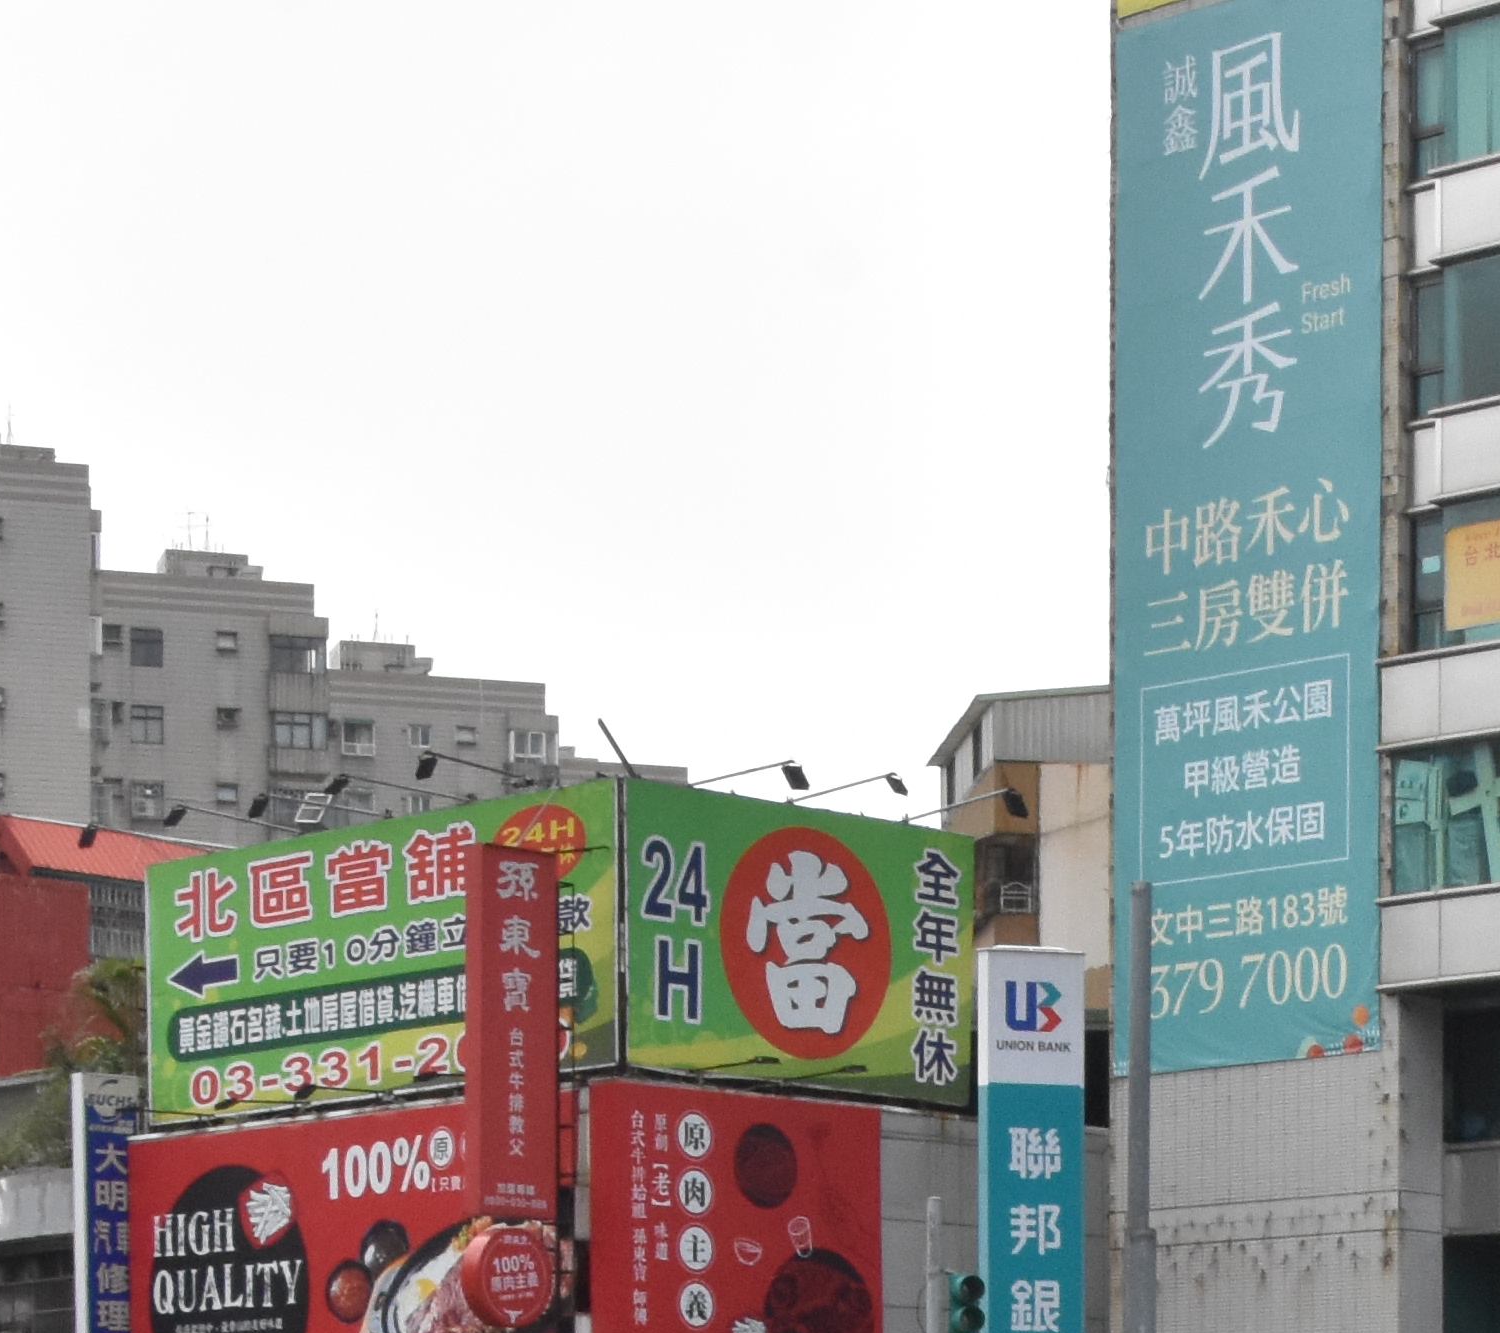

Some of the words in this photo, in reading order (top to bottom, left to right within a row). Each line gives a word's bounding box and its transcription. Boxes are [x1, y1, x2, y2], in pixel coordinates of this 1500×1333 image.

[1163, 55, 1198, 156] 誠鑫
[1199, 31, 1299, 450] 風禾秀
[1302, 274, 1351, 303] Fresh
[1302, 308, 1345, 334] Start
[1145, 478, 1349, 575] 中路禾心
[1144, 560, 1349, 657] 三房雙併
[1154, 679, 1333, 745] 萬坪風禾公園
[1183, 746, 1301, 798] 甲級營造
[1159, 803, 1325, 859] 5年防水保固
[175, 822, 476, 942] 北區當舖
[641, 837, 710, 924] 24
[746, 851, 869, 1034] 當
[1150, 885, 1348, 946] 文中三路183號
[655, 937, 701, 1023] H
[913, 850, 959, 1083] 全年無休
[1238, 944, 1348, 1011] 7000
[996, 1038, 1035, 1053] UNION
[1038, 1040, 1072, 1054] BANK
[322, 1134, 430, 1200] 100%
[153, 1207, 237, 1258] HIGH
[493, 1254, 535, 1274] 100%
[153, 1259, 303, 1316] QUALITY
